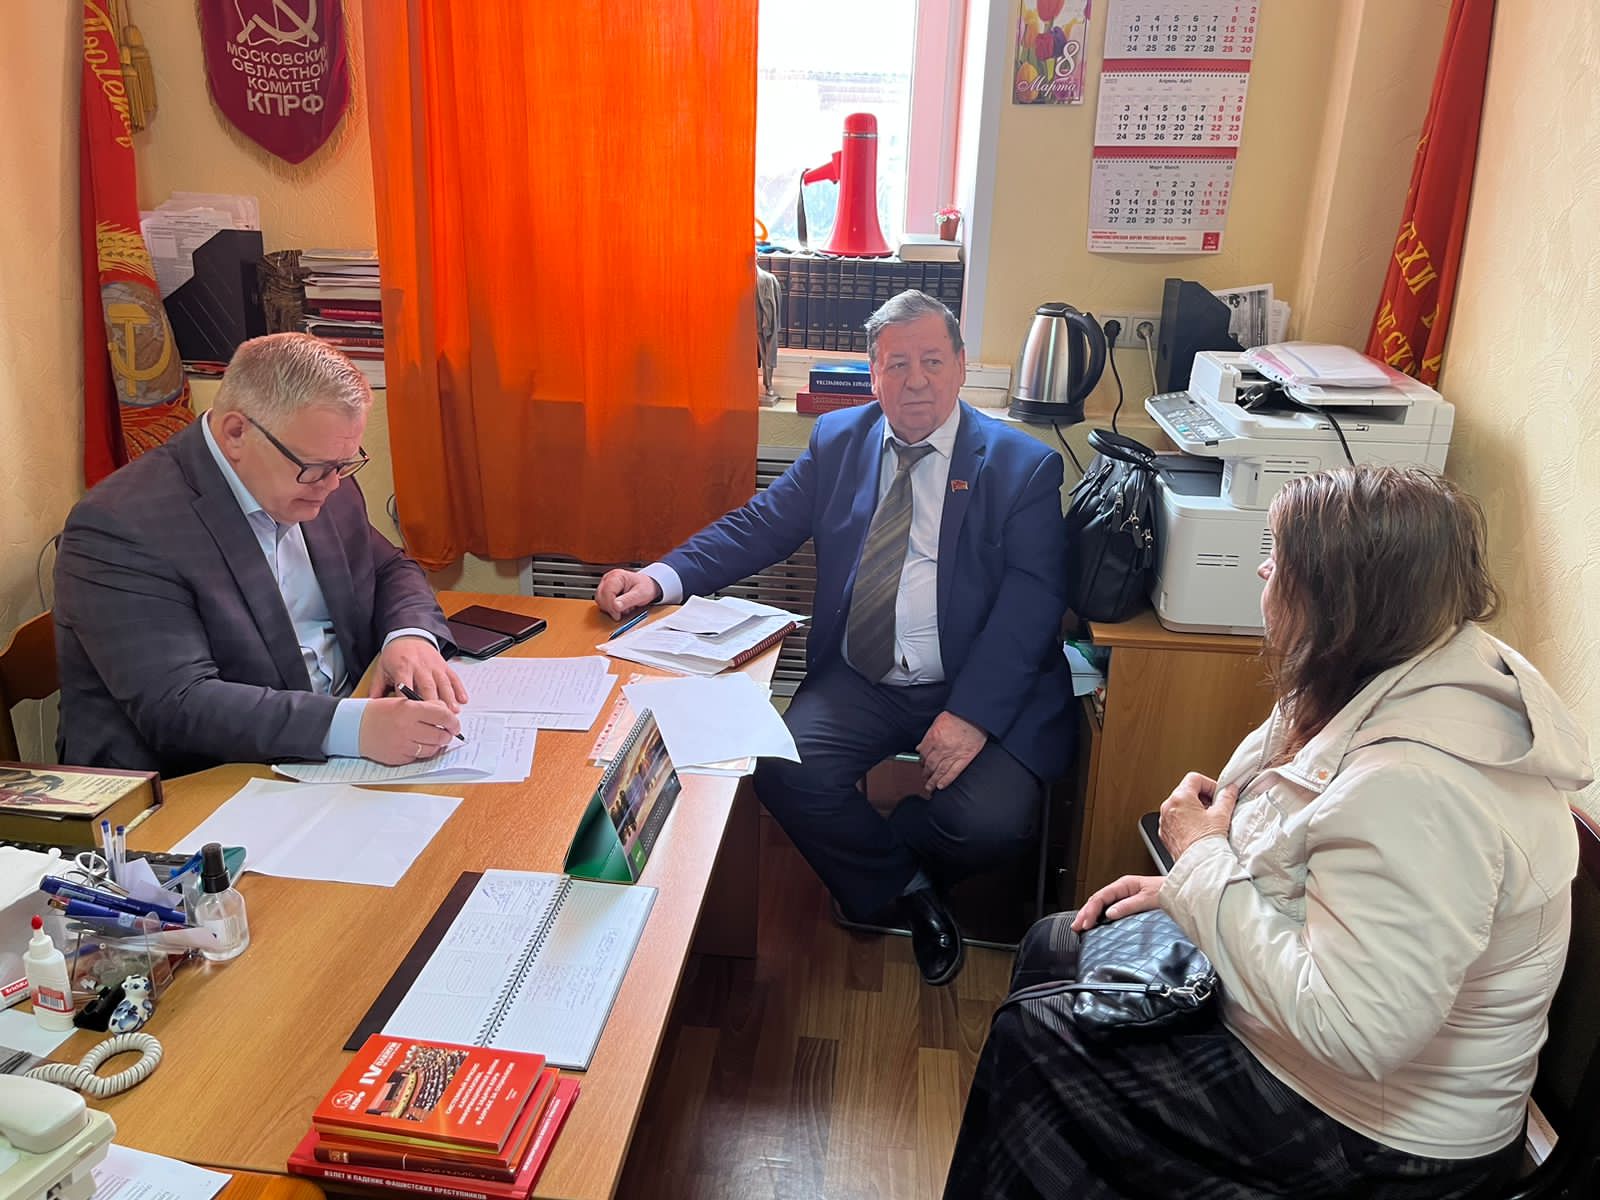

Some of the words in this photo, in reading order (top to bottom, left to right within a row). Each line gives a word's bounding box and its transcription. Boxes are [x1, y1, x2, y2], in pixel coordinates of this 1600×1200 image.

[1206, 25, 1217, 33] 14
[232, 57, 328, 80] ОБЛАСТНОЙ
[1055, 41, 1080, 77] 8
[247, 76, 320, 94] КОМИТЕТ
[1017, 75, 1077, 97] Марта
[246, 89, 324, 117] КПРФ
[1162, 104, 1168, 112] 5
[1200, 104, 1206, 112] 7
[359, 1064, 382, 1084] IV
[353, 1174, 384, 1185] ПАДЕНИЕ
[385, 1179, 432, 1192] ФАШИСТСКИХ
[434, 1186, 487, 1200] ПРЕСТУПНИКОВ
